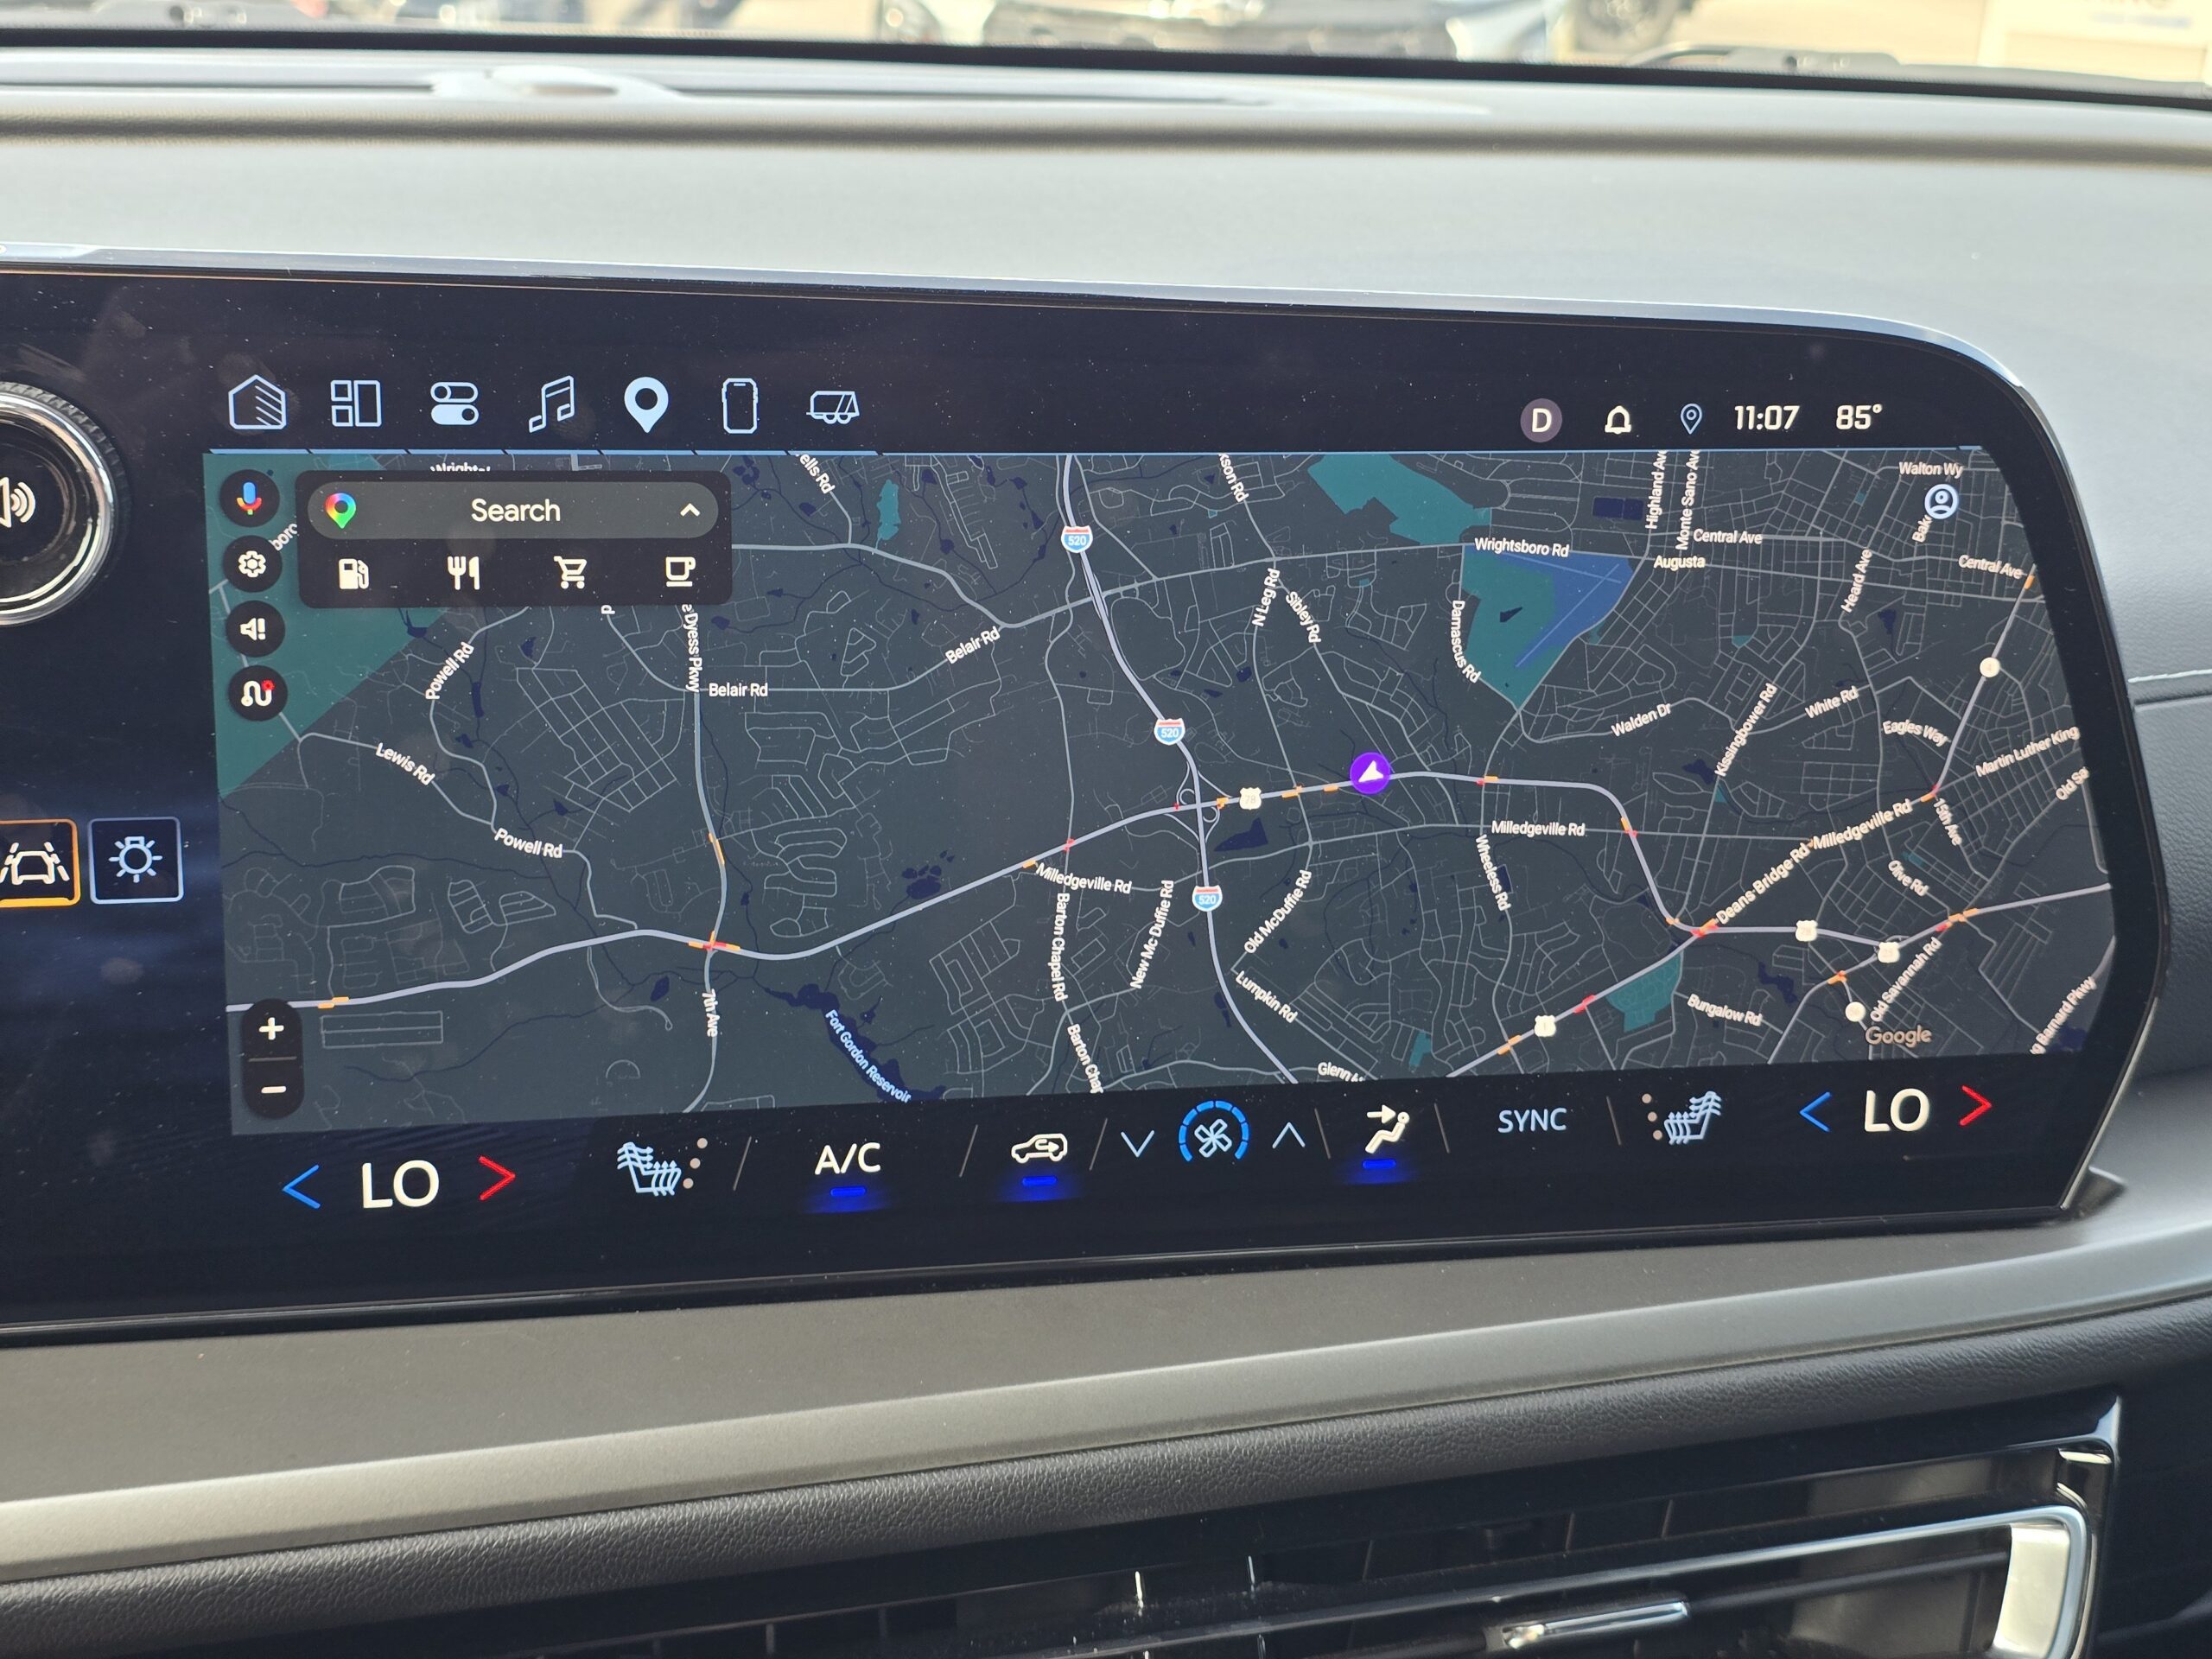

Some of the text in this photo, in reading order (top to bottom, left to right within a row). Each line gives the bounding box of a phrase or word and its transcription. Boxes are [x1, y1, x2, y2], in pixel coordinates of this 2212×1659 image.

[1531, 408, 1552, 433] D
[1734, 404, 1800, 430] 11:07
[1835, 404, 1883, 430] 85°
[816, 473, 836, 493] Rd
[1898, 461, 1963, 480] Walton Wy
[1230, 481, 1249, 503] Rd
[1644, 471, 1665, 530] Highland
[1681, 472, 1698, 507] Sano
[471, 499, 561, 522] Search
[1068, 535, 1087, 546] 520
[1675, 508, 1693, 550] Monte
[1693, 528, 1764, 545] Central Ave
[1474, 537, 1571, 558] Wrightsboro Rd
[1653, 555, 1706, 571] Augusta
[1840, 549, 1873, 613] Heard Ave
[1958, 554, 2024, 581] Central Ave
[1252, 567, 1281, 627] N Leg Rd
[683, 613, 699, 655] Dyess
[1285, 591, 1322, 644] Sibley Rd
[945, 626, 1001, 664] Belair Rd
[1451, 600, 1481, 683] Damascus Rd
[425, 641, 474, 700] Powell Rd
[685, 657, 703, 693] Pkwy
[709, 683, 768, 697] Belair Rd
[1805, 685, 1859, 719] White Rd
[1161, 728, 1179, 738] 520
[1611, 702, 1672, 736] Walden Dr
[1714, 682, 1778, 777] Kissingbower Rd
[1882, 719, 1949, 747] Eagles Way
[375, 742, 435, 785] Lewis Rd
[1975, 727, 2081, 777] Martin Luther King
[2056, 766, 2089, 800] Old Sa
[1491, 820, 1586, 838] Milledgeville Rd
[1813, 798, 1913, 849] Milledgeville Rd
[1933, 798, 1962, 846] 15th Ave
[493, 828, 563, 859] Powell Rd
[1036, 862, 1133, 893] Milledgeville Rd
[1476, 834, 1511, 912] Wheeless Rd
[1716, 842, 1811, 925] Deans Bridge Rd
[1888, 860, 1930, 897] Olive Rd
[1199, 894, 1217, 905] 520
[1243, 869, 1313, 954] Old McDuffie Rd
[1047, 893, 1071, 1001] Barton Chapel Rd
[1130, 880, 1174, 988] New Mc Duffie Rd
[1236, 970, 1298, 1024] Lumpkin Rd
[1870, 1000, 1889, 1021] Old
[1881, 950, 1930, 1004] Savannah
[1923, 937, 1942, 957] Rd
[702, 988, 721, 1038] 7th Ave
[1687, 993, 1763, 1027] Bungalow Rd
[2036, 1001, 2075, 1046] Barnard
[2066, 976, 2097, 1006] Pkwy
[1067, 1023, 1090, 1066] Barton
[1866, 1025, 1932, 1048] Google
[825, 1009, 912, 1104] Fort Gordon Reservoir
[1318, 1061, 1352, 1082] Glenn
[1497, 1107, 1567, 1135] SYNC
[1864, 1087, 1930, 1134] LO
[814, 1141, 881, 1176] A/C
[360, 1159, 440, 1209] LO
